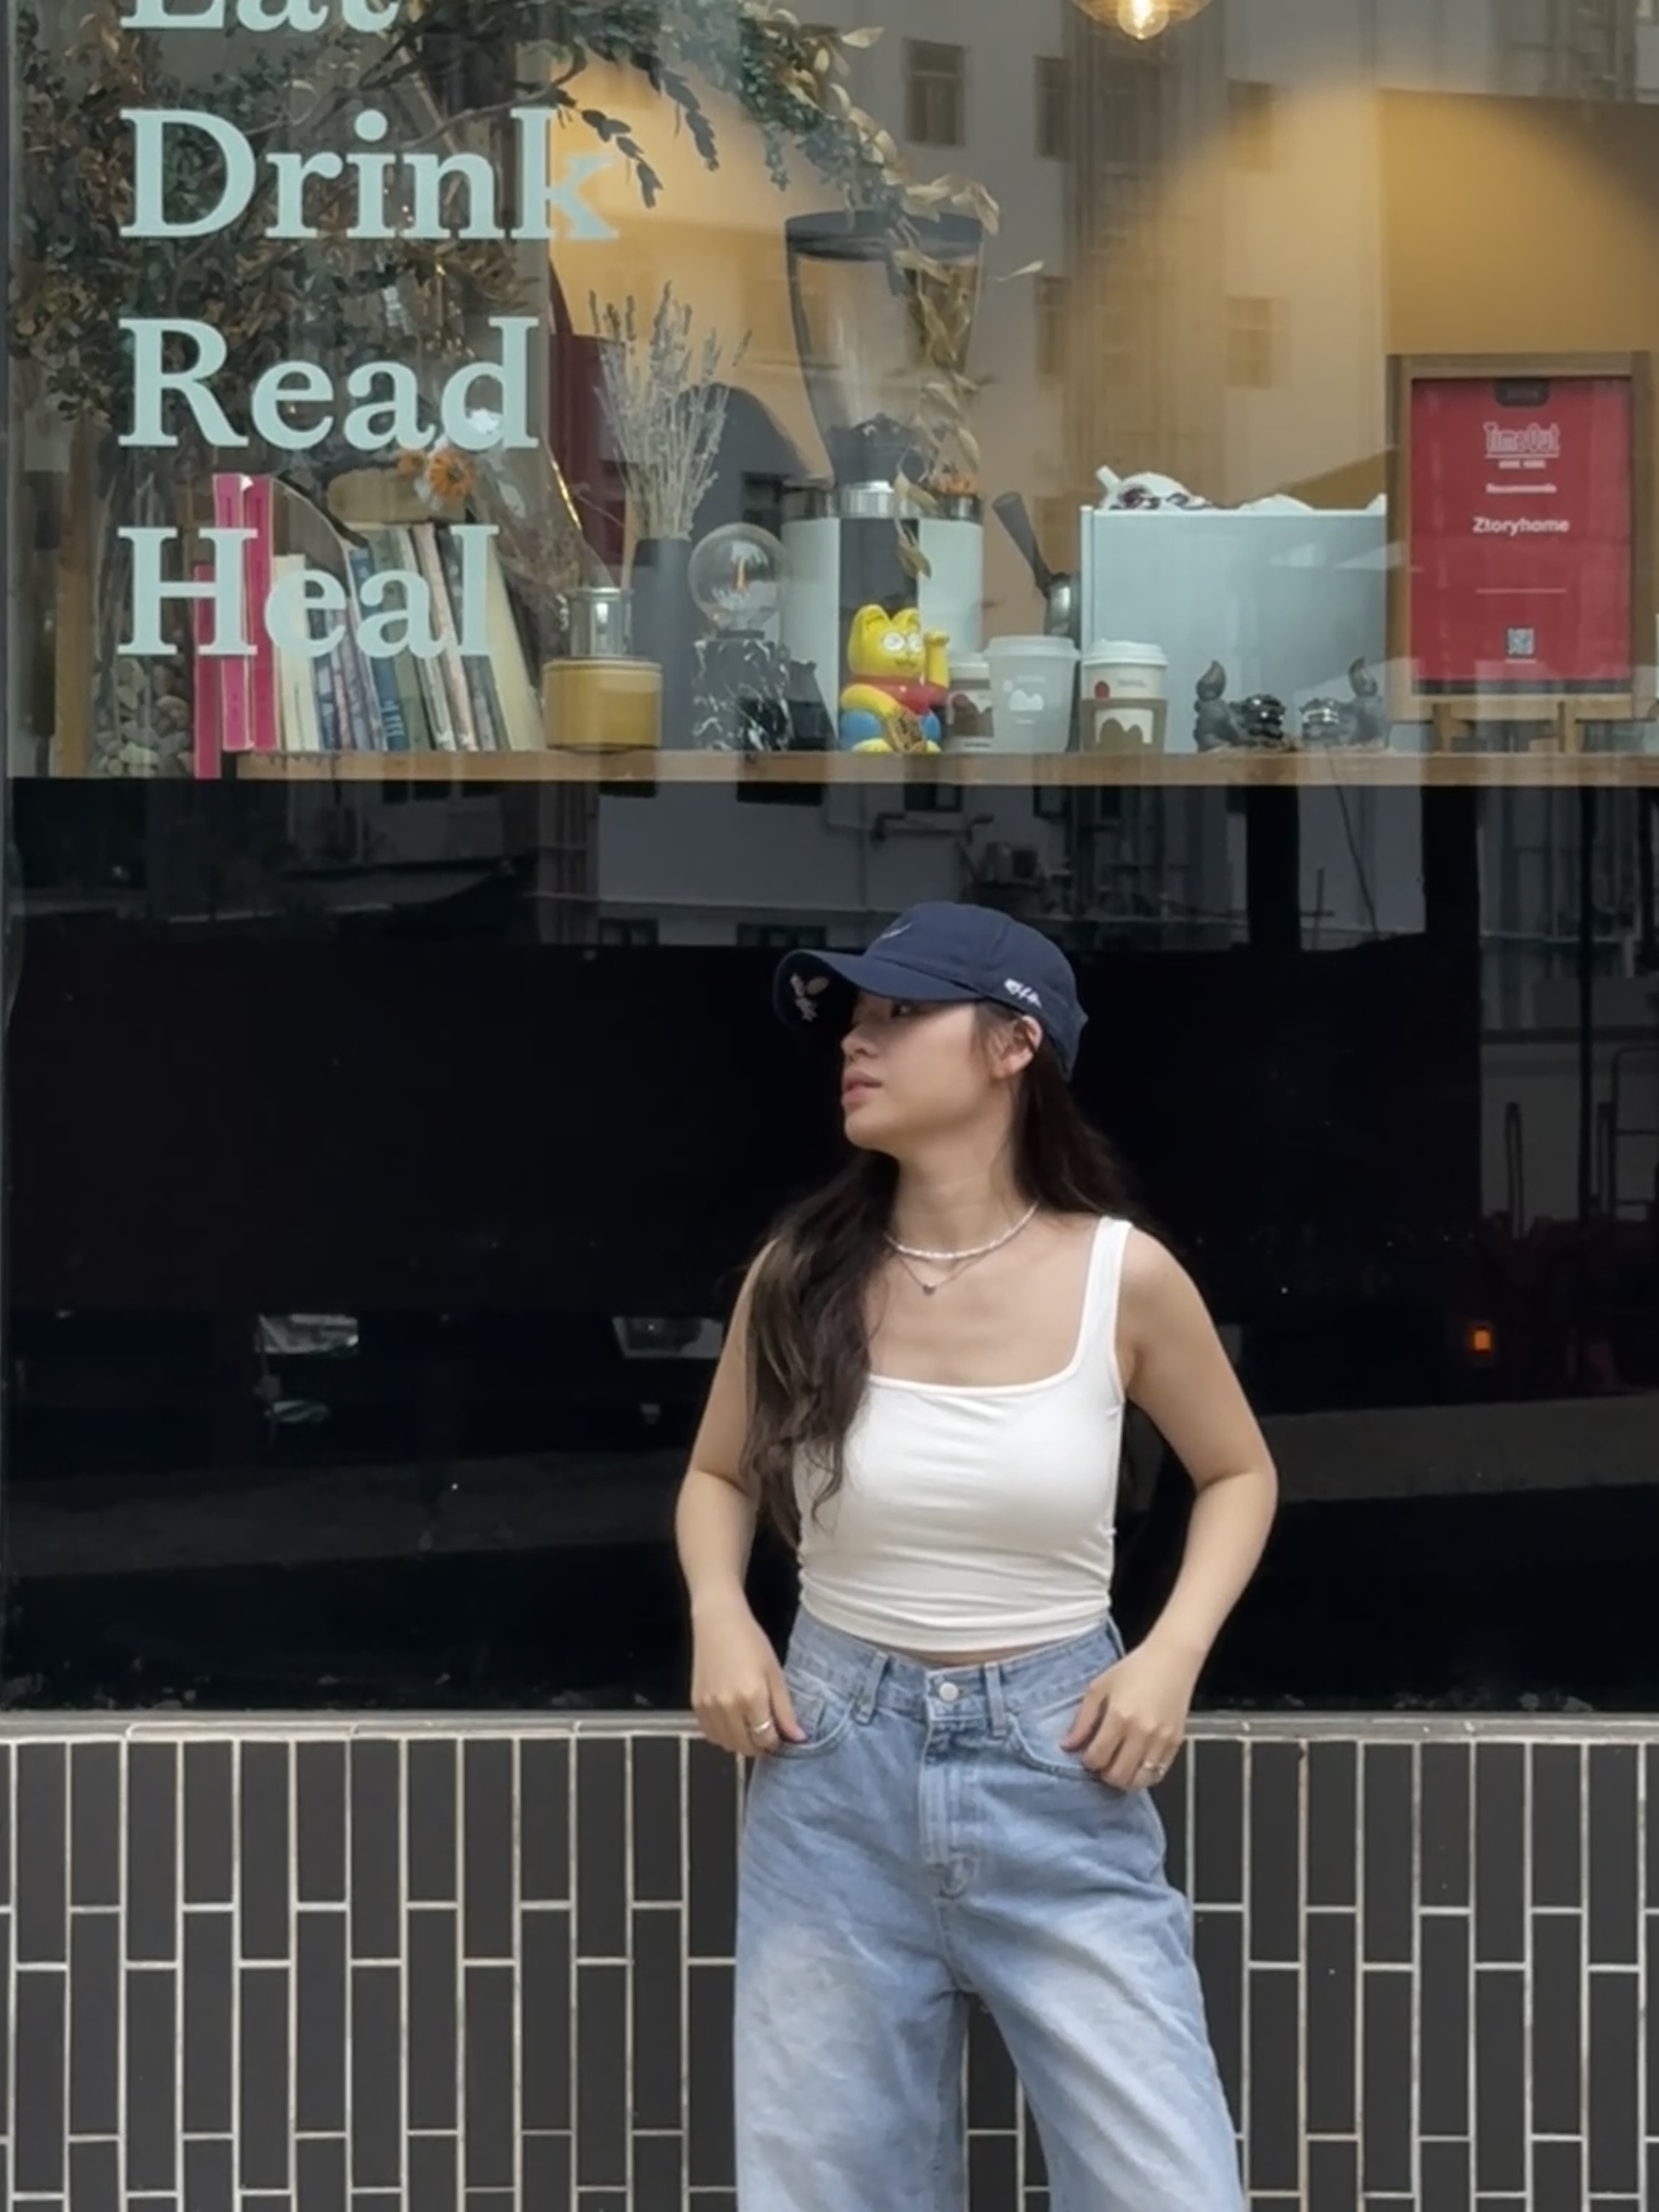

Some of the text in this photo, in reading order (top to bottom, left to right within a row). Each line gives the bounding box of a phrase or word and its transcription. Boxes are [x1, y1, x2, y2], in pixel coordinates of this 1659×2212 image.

[119, 108, 619, 239] Drink
[119, 317, 539, 450] Read
[118, 525, 500, 658] Heal
[1472, 516, 1569, 537] Ztoryhome
